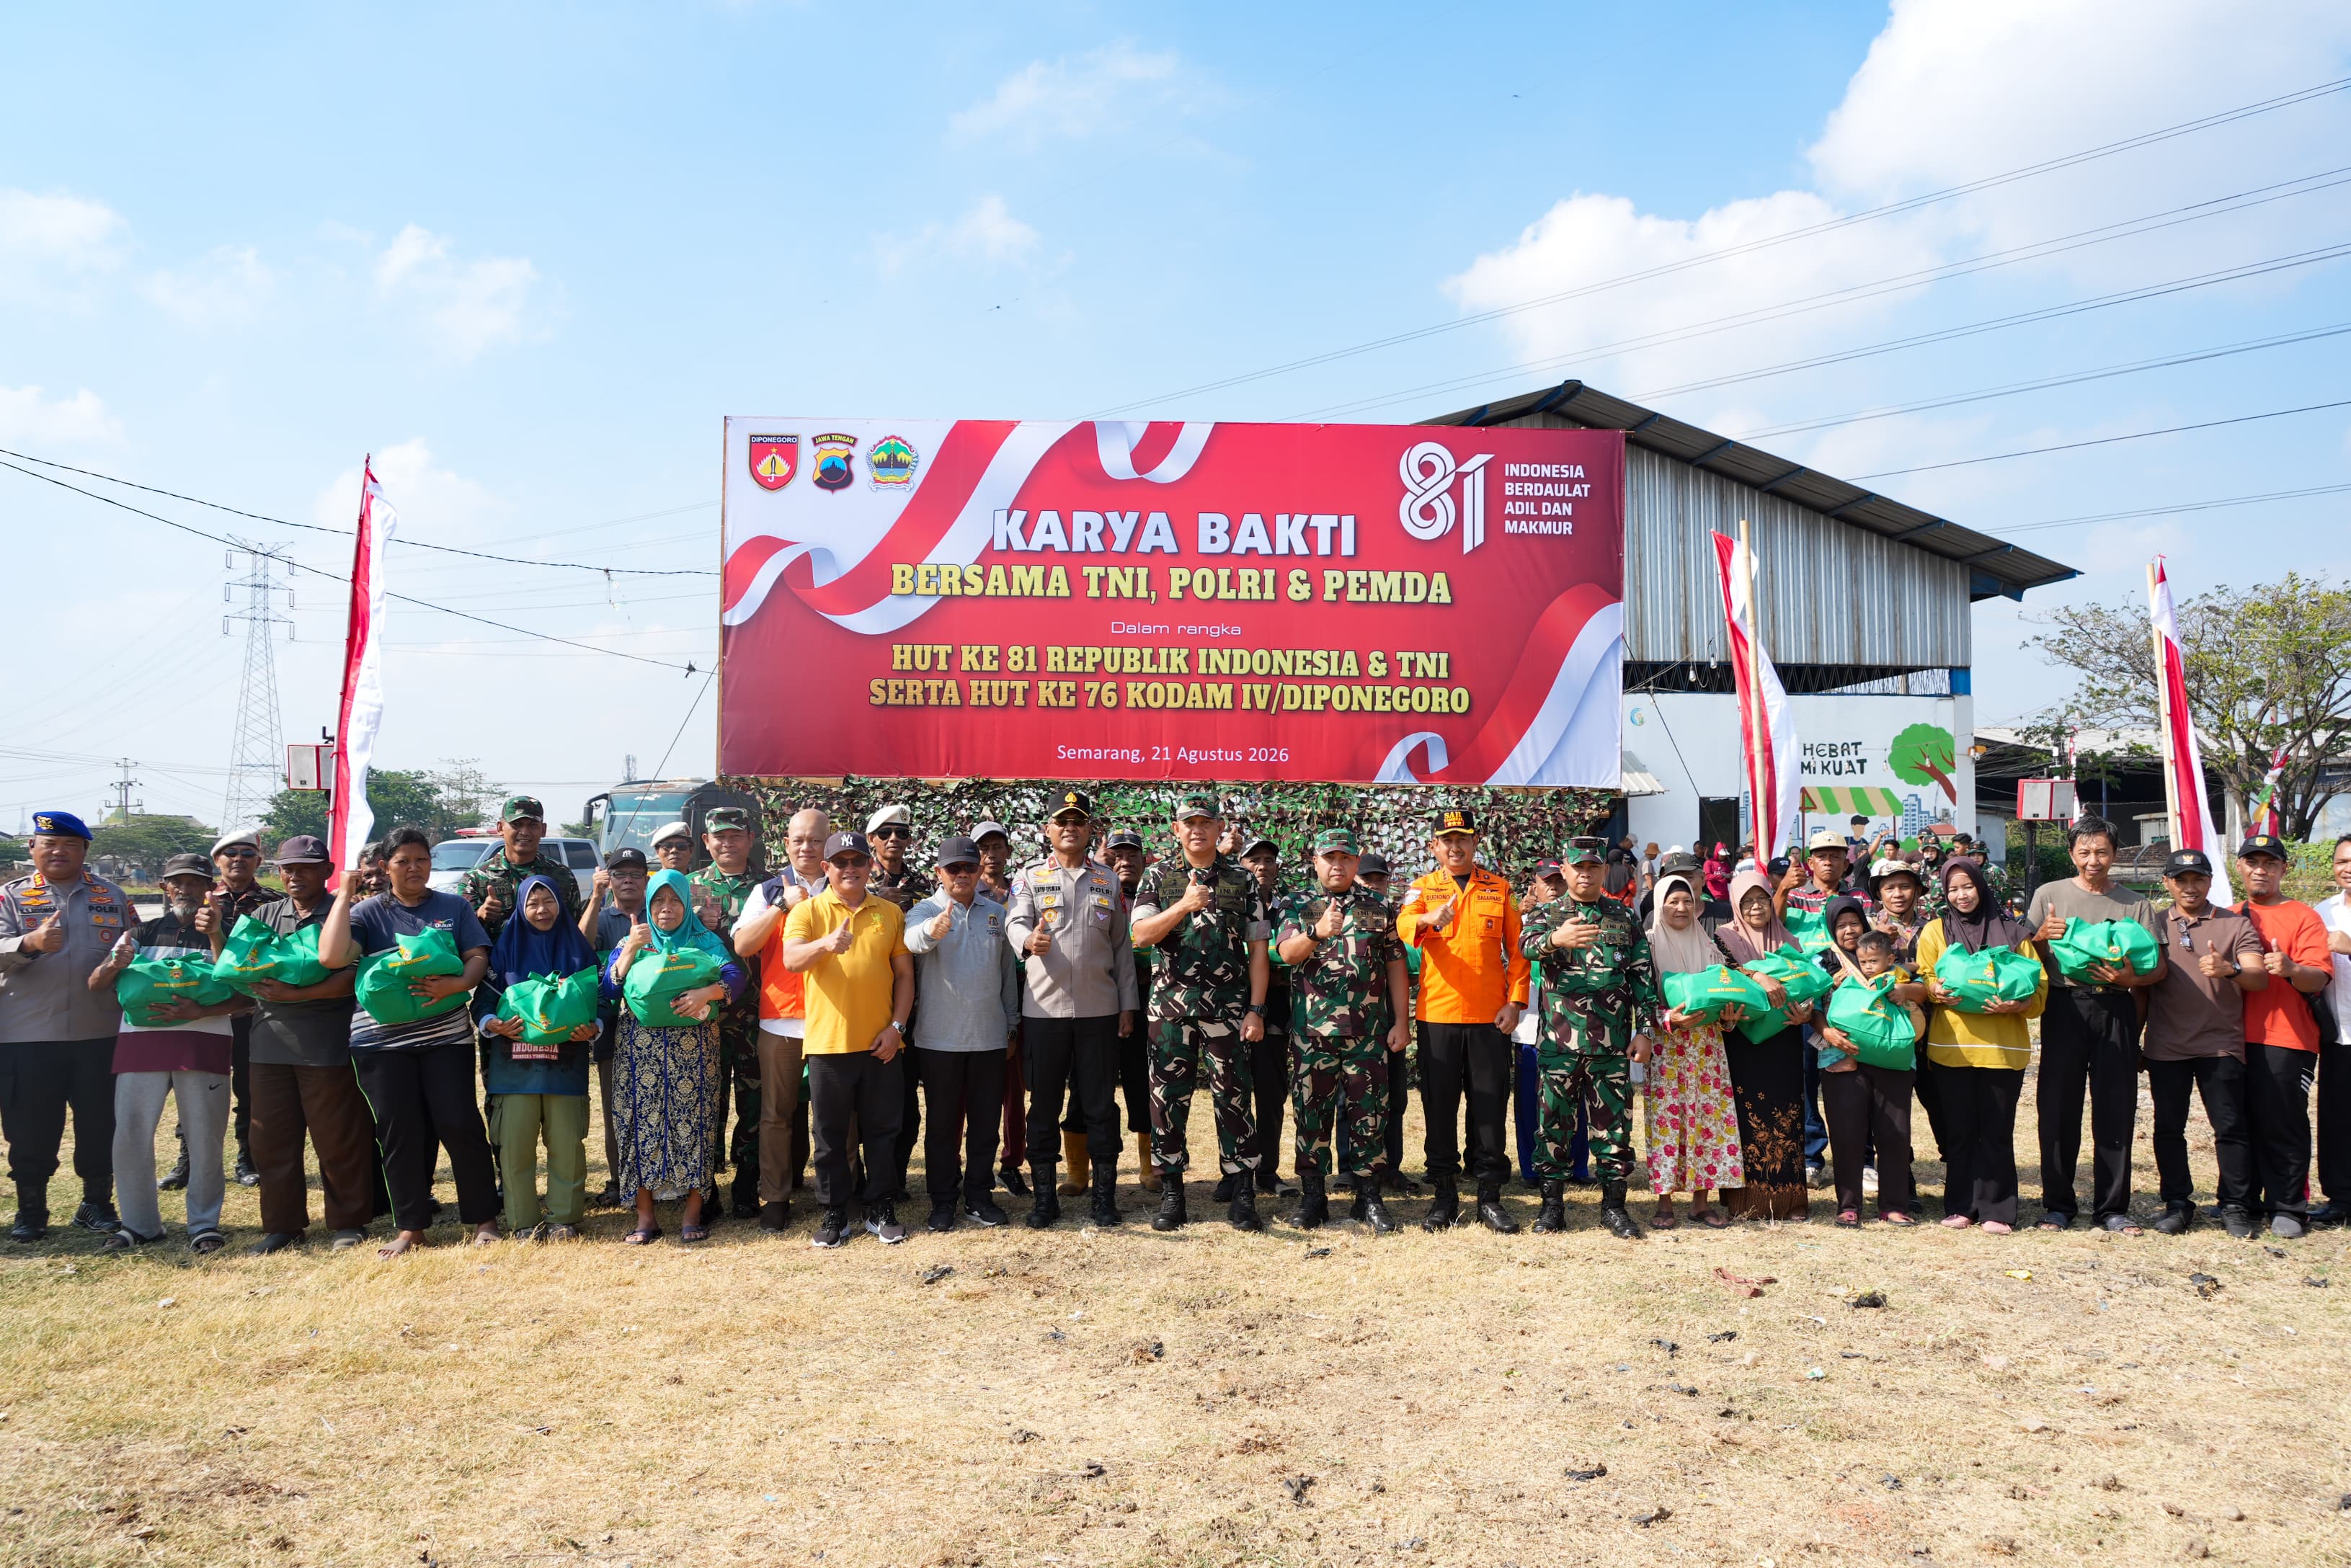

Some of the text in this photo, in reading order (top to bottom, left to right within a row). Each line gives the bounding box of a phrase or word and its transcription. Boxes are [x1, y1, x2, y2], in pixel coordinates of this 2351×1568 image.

[832, 435, 855, 444] TENGAH
[1504, 463, 1585, 478] INDONESIA
[1399, 441, 1496, 555] 81
[1504, 482, 1591, 497] BERDAULAT
[1504, 502, 1573, 516] ADIL DAN
[993, 509, 1356, 557] KARYA BAKTI
[1504, 520, 1573, 535] MAKMUR
[891, 564, 1452, 604] BERSAMA TNI, POLRI & PEMDA
[1111, 621, 1242, 638] Dalam rangka
[891, 644, 1449, 679] HUT KE 81 REPUBLIK INDONESIA & TNI
[869, 678, 1470, 715] SERTA HUT KE 76 KODAM IV/DIPONEGORO
[1057, 745, 1289, 765] Semarang, 21 Agustus 2026
[1803, 741, 1862, 758] HEBAT
[1800, 758, 1867, 776] MI KUAT
[1090, 886, 1112, 896] POLRI
[88, 905, 118, 914] POLRI
[512, 1043, 559, 1053] INDONESIA
